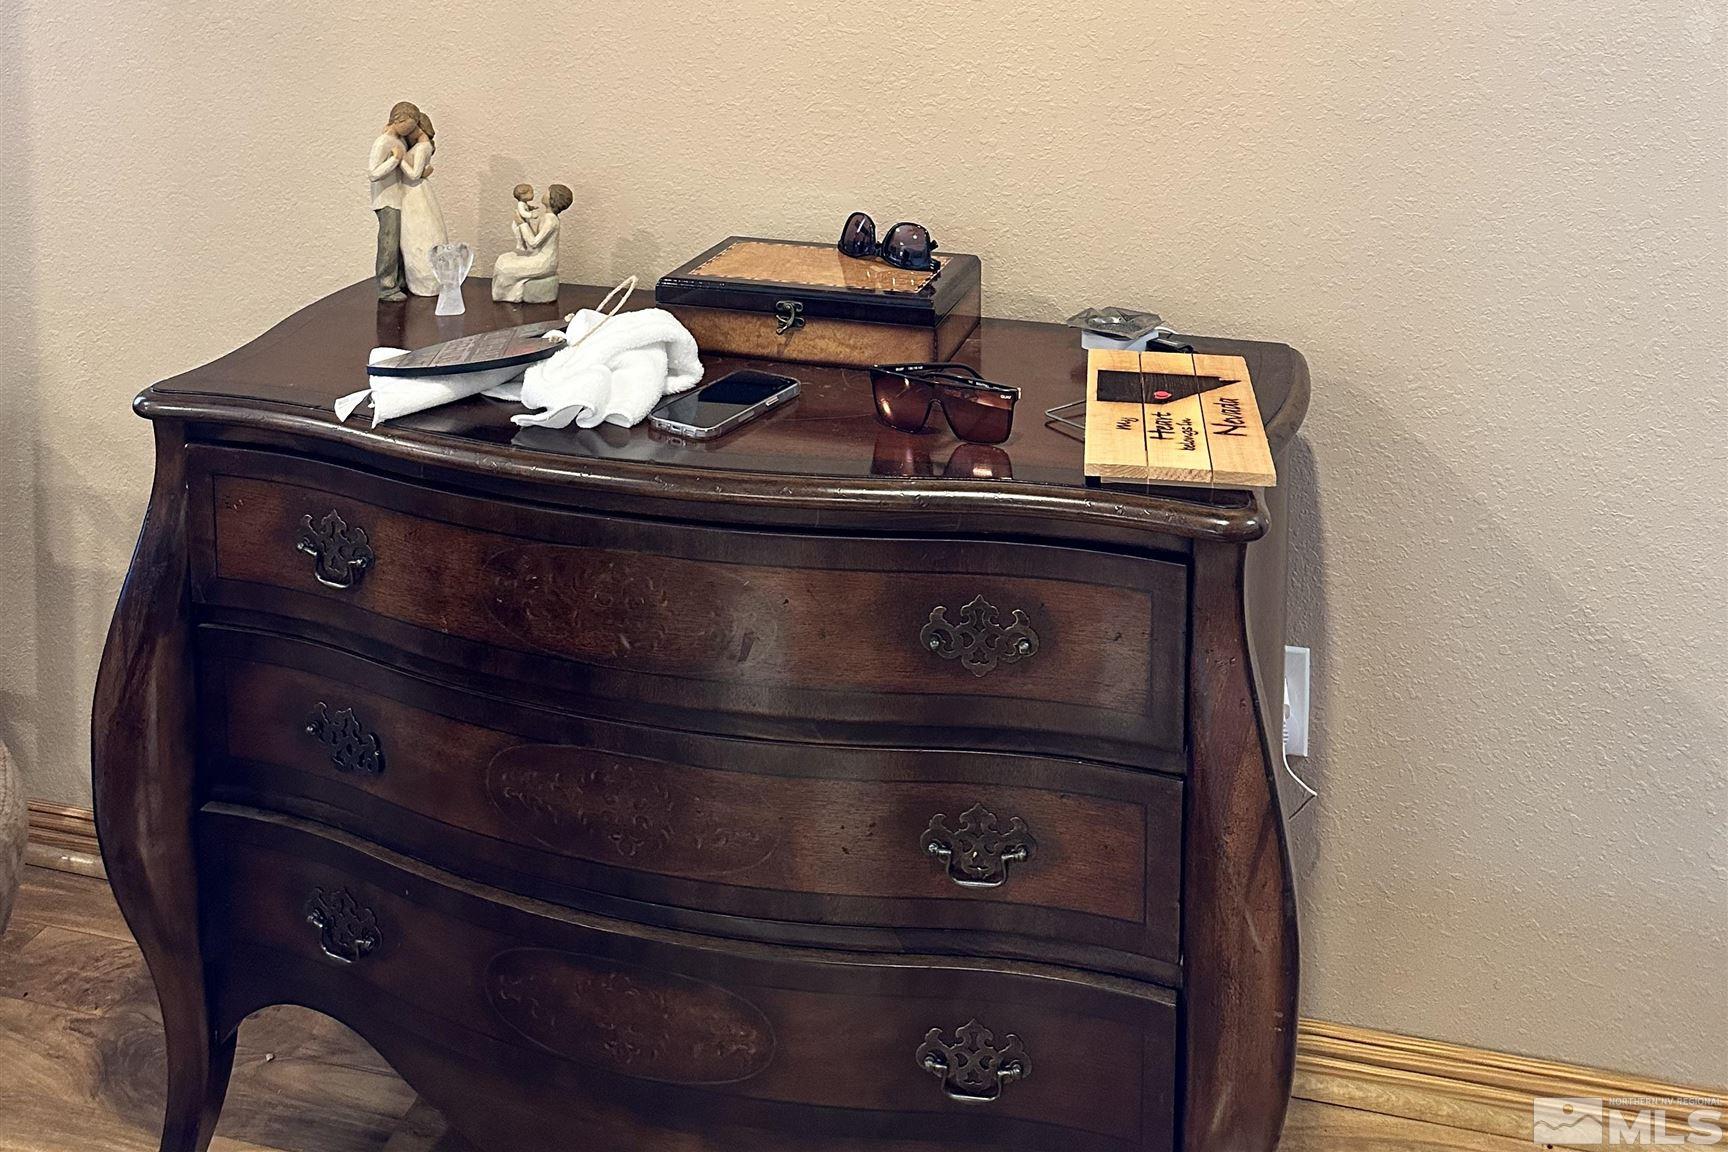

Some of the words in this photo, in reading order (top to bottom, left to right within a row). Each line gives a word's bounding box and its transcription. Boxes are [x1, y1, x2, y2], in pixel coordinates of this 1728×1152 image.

[1115, 417, 1139, 430] My
[1148, 411, 1175, 440] Heart
[1211, 397, 1248, 436] Nevada
[1177, 426, 1199, 451] belongs
